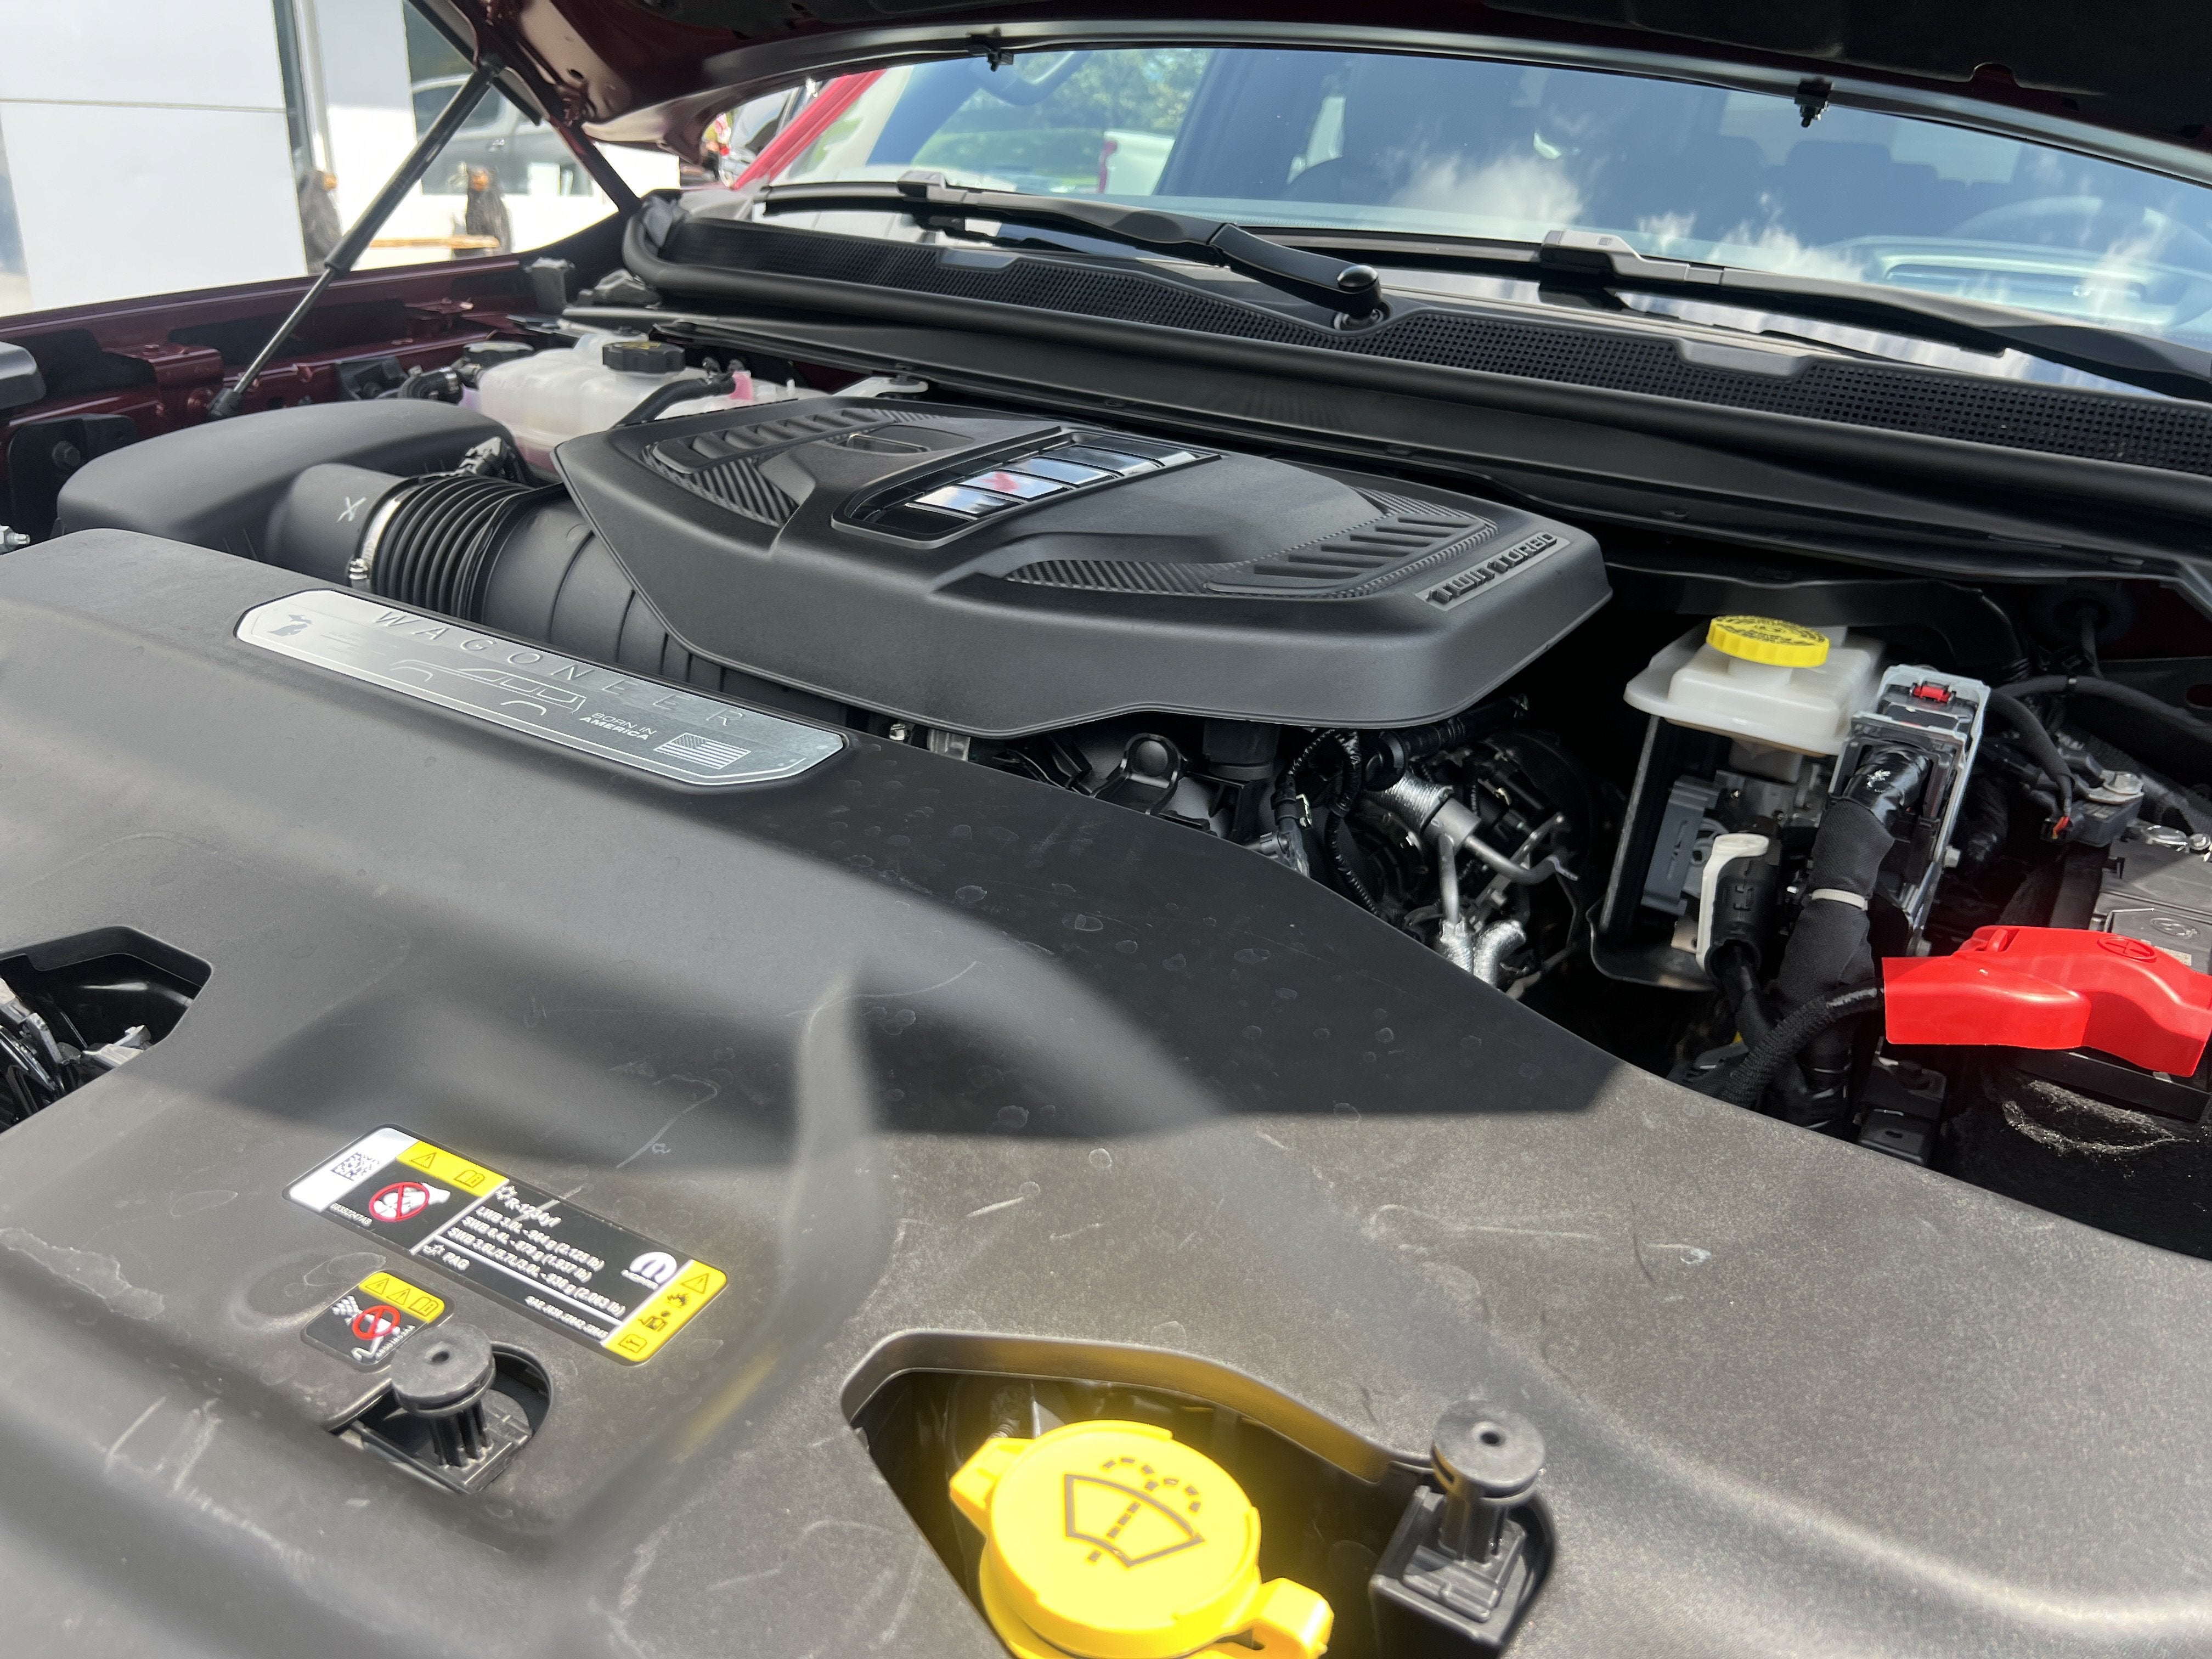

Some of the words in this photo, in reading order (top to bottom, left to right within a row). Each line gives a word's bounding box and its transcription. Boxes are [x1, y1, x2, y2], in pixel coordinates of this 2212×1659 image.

[1426, 568, 1495, 604] TWIN
[1487, 533, 1558, 574] TURBO
[371, 611, 744, 726] WAGONEER
[579, 716, 649, 740] AMERICA
[591, 713, 638, 729] BORN
[639, 727, 657, 735] IN
[504, 1198, 562, 1228] R-1234yf
[442, 1252, 470, 1271] PAG
[461, 1216, 490, 1234] SWB
[487, 1228, 510, 1245] 6.4L
[573, 1267, 592, 1283] lb)
[476, 1206, 503, 1223] LWB
[500, 1217, 522, 1234] 3.0L
[555, 1243, 590, 1263] (2.125
[586, 1256, 605, 1272] lb)
[447, 1227, 476, 1245] SWB
[472, 1239, 540, 1278] 3.6L/5.7L/3.0L
[573, 1287, 610, 1309] (2.063
[607, 1301, 626, 1317] lb)
[524, 1295, 546, 1311] SAE
